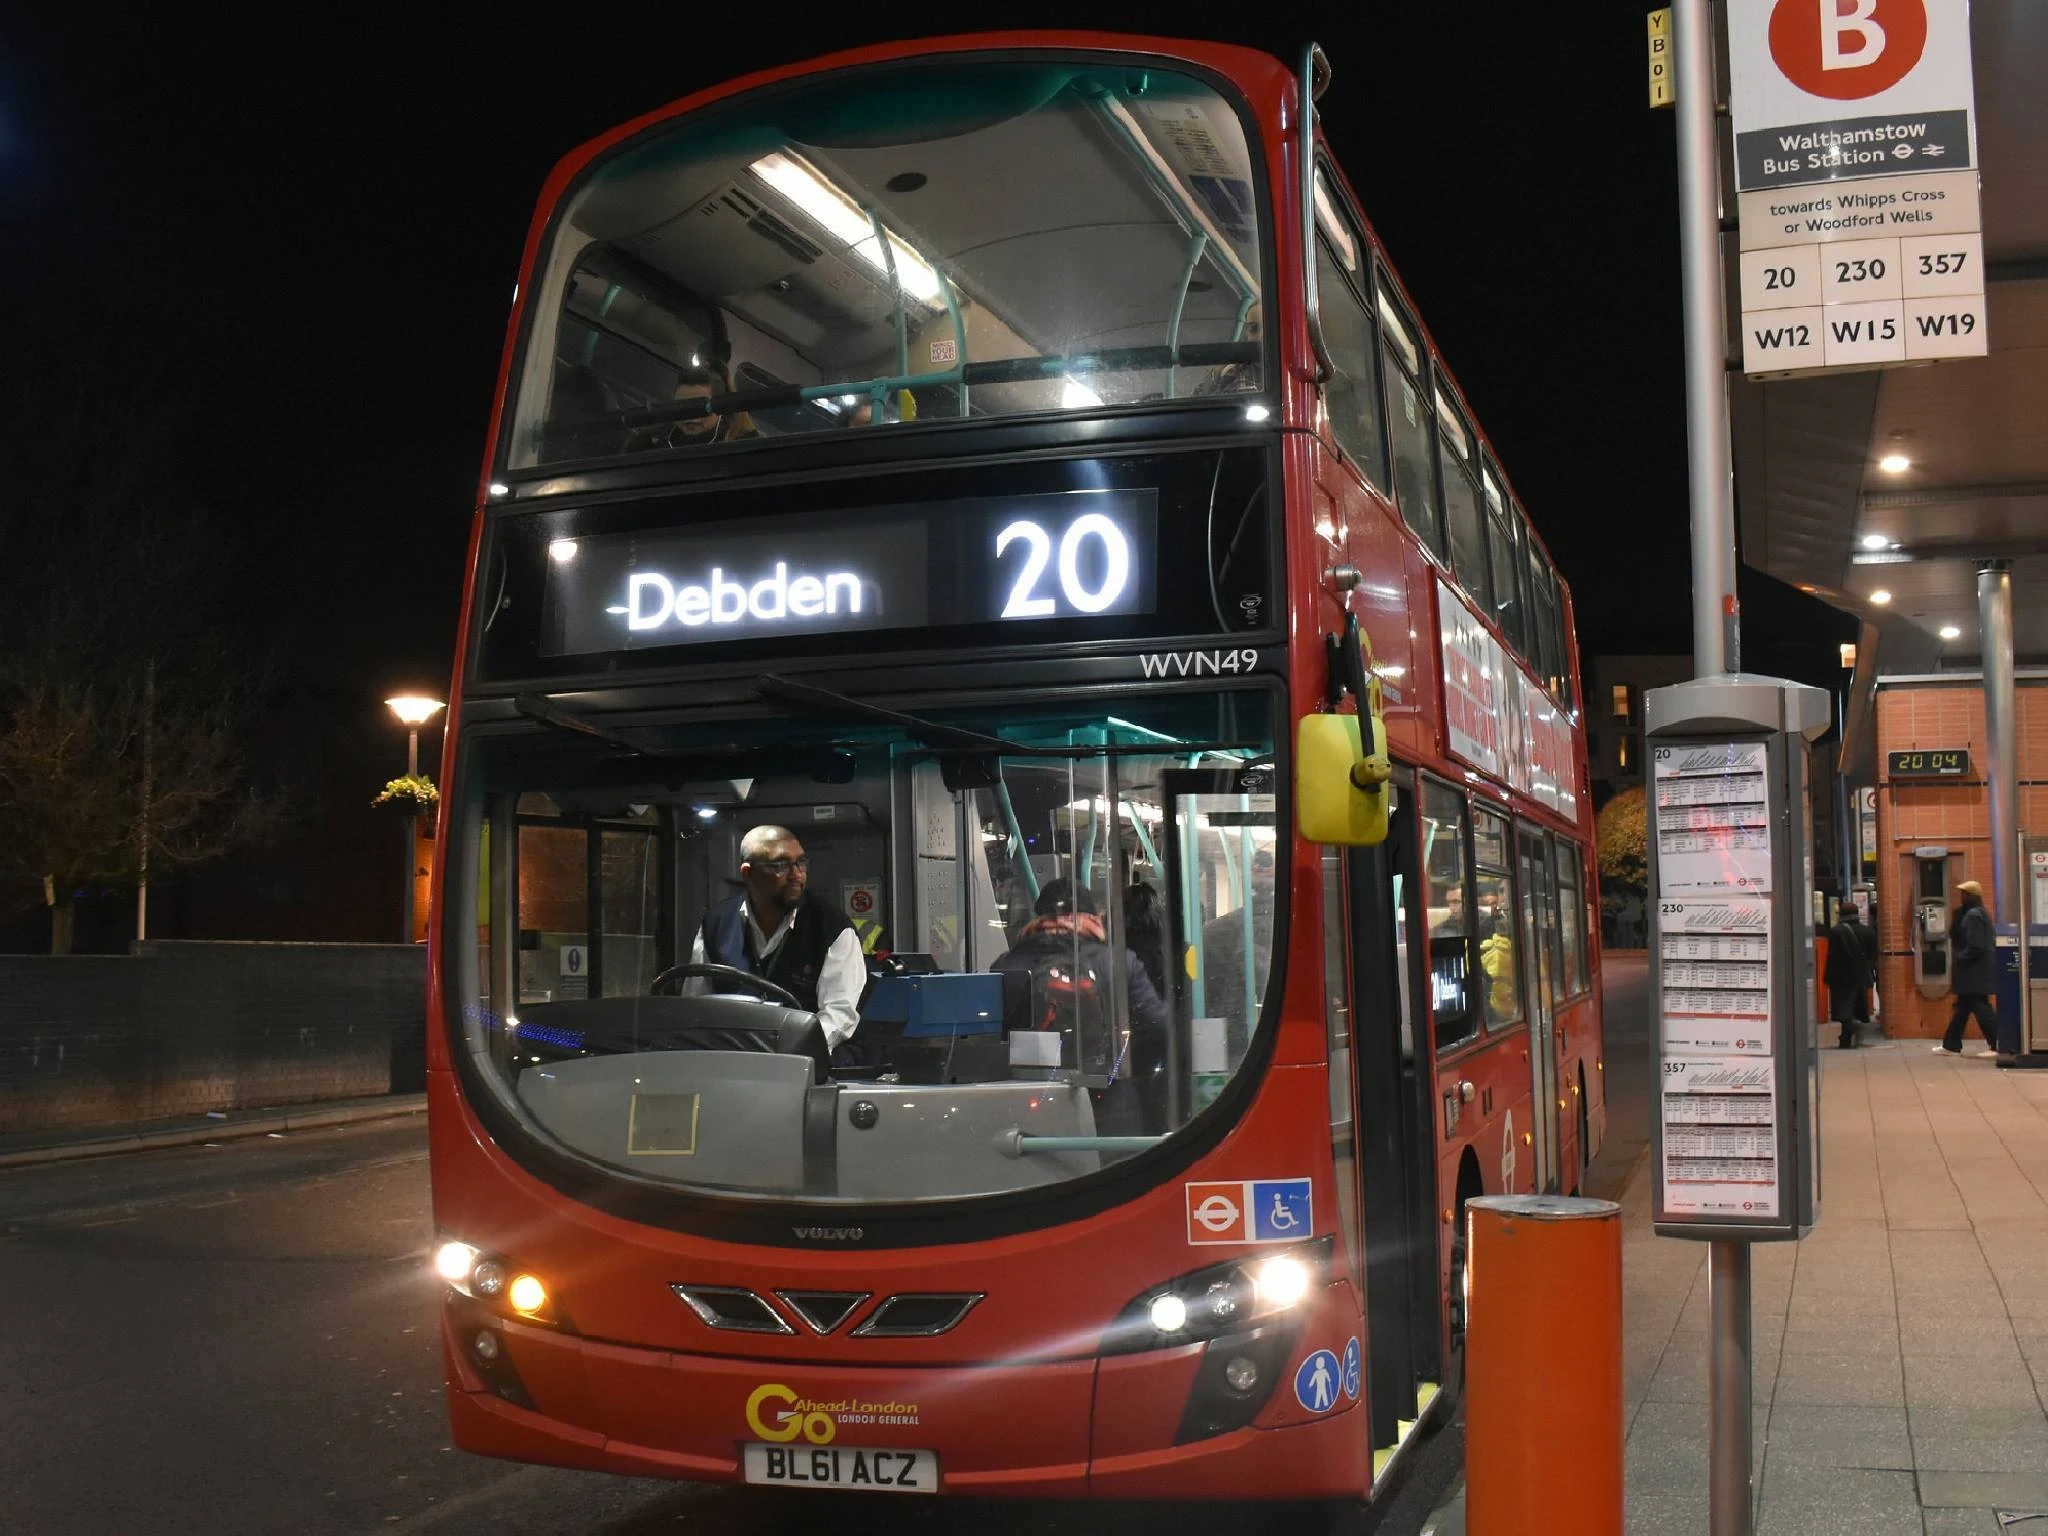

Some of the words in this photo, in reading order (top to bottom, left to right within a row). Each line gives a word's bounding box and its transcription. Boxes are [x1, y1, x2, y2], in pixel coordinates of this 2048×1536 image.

[1821, 0, 1886, 71] B
[1779, 122, 1926, 151] Walthamstow
[1763, 157, 1800, 175] Bus
[1808, 148, 1885, 169] Station
[1770, 198, 1832, 216] towards
[1837, 192, 1897, 211] Whipps
[1902, 189, 1946, 202] Cross
[1784, 222, 1799, 234] or
[1806, 212, 1884, 232] Woodford
[1890, 210, 1933, 223] Wells
[1763, 266, 1796, 290] 20
[1835, 259, 1886, 283] 230
[1918, 252, 1967, 275] 357
[1755, 325, 1811, 349] W12
[1831, 318, 1896, 344] W15
[1916, 313, 1976, 337] W19
[996, 513, 1129, 618] 20
[629, 562, 861, 631] Debden
[1139, 648, 1258, 678] WVN49
[1655, 749, 1671, 760] 20
[1899, 754, 1923, 769] 20
[1932, 753, 1958, 769] 04
[1662, 904, 1684, 913] 230
[1664, 1062, 1686, 1073] 357
[792, 1227, 864, 1240] VOLVO
[746, 1383, 836, 1444] Go
[837, 1413, 876, 1424] LONDON
[878, 1414, 919, 1425] GENERAL
[766, 1448, 840, 1482] BL61
[851, 1451, 917, 1487] ACZ
